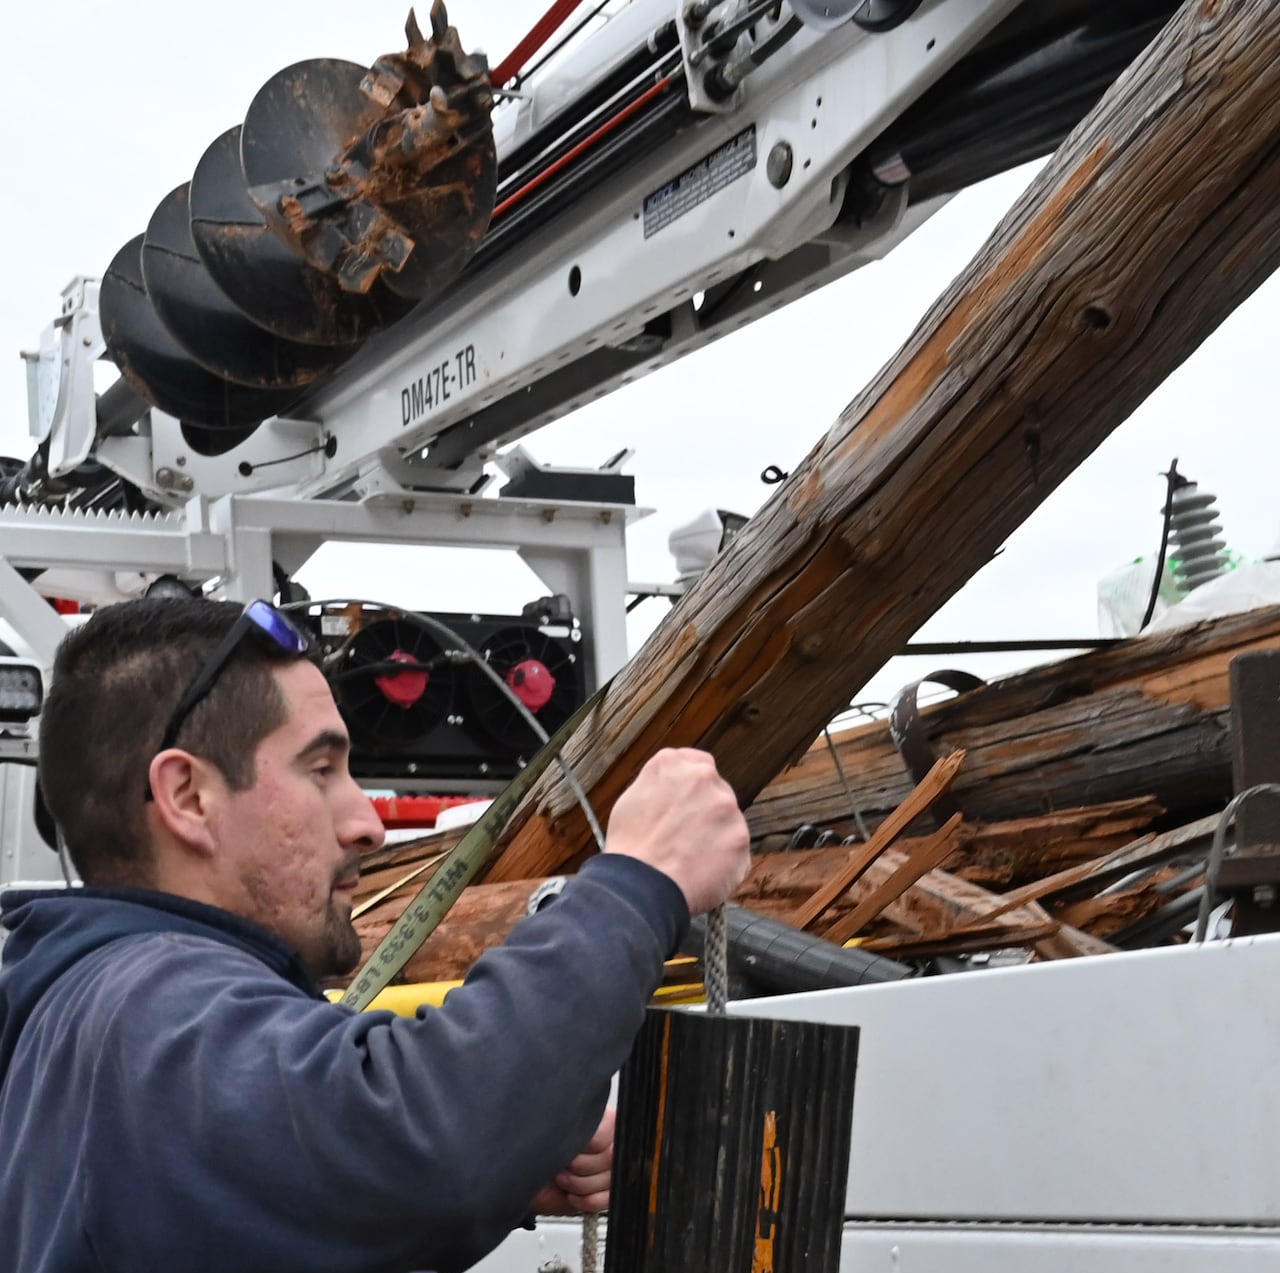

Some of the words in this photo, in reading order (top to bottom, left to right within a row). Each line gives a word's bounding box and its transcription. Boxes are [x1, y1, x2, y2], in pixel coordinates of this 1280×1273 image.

[401, 343, 477, 427] DM47E-TR
[427, 857, 469, 903] WLL
[379, 908, 430, 965] 3,333
